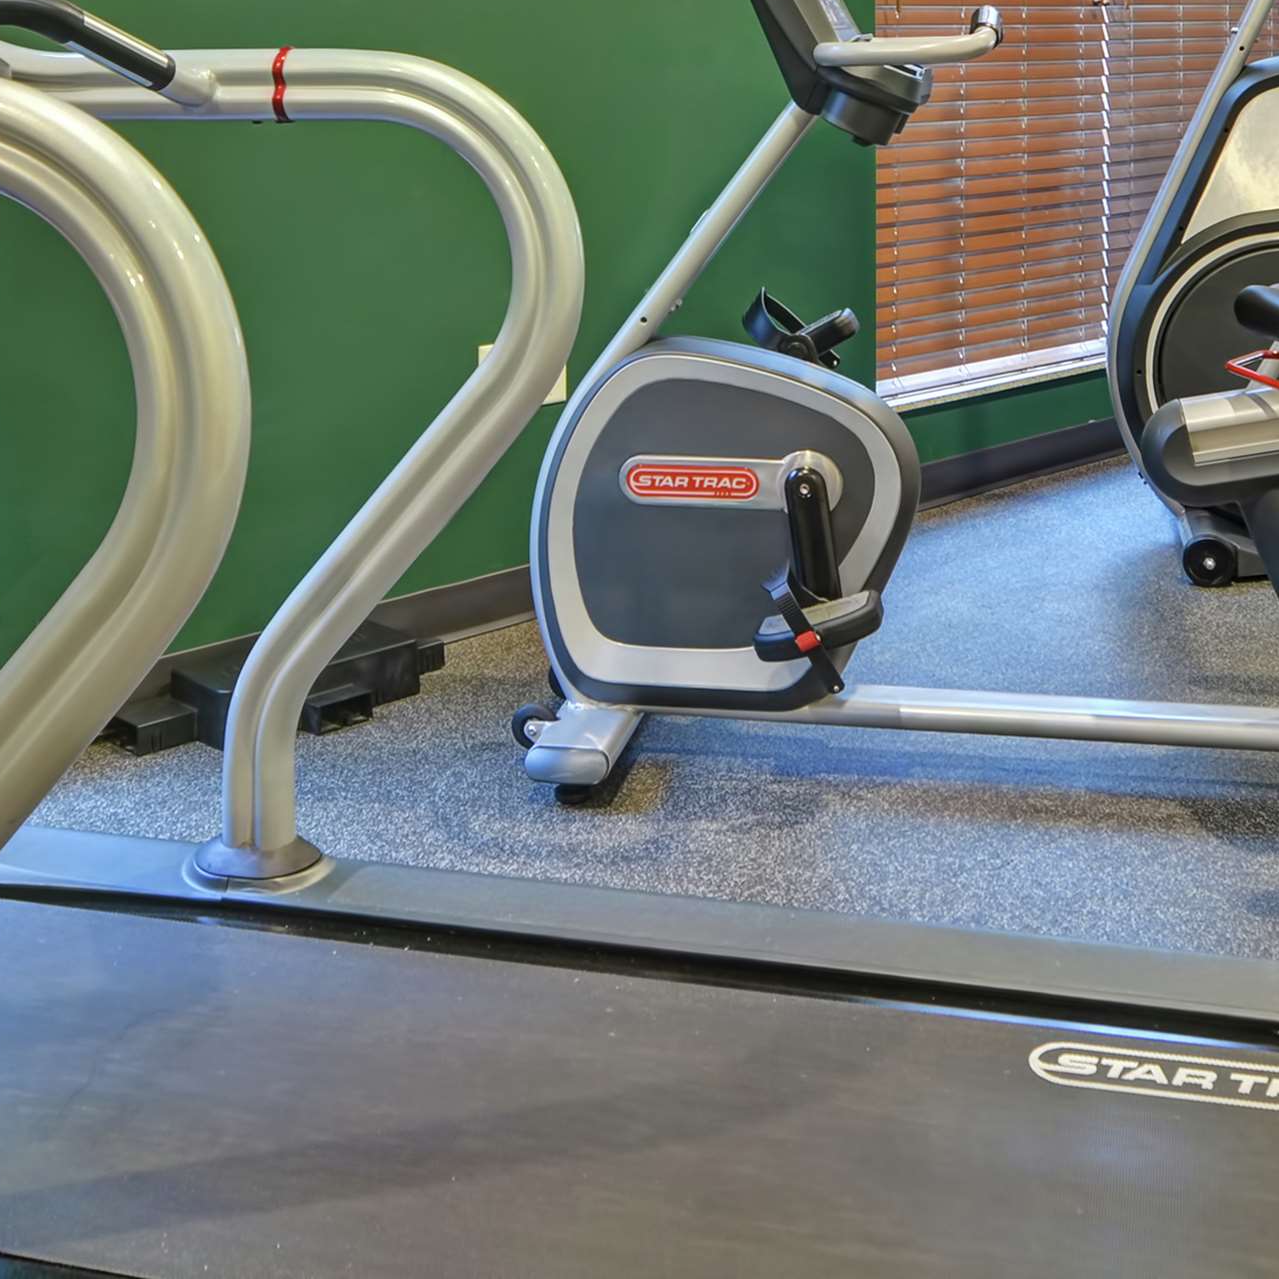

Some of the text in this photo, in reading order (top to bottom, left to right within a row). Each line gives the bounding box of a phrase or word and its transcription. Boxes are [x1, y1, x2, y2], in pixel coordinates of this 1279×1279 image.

[636, 475, 746, 489] STAR TRAC
[1040, 1052, 1218, 1091] STAR
